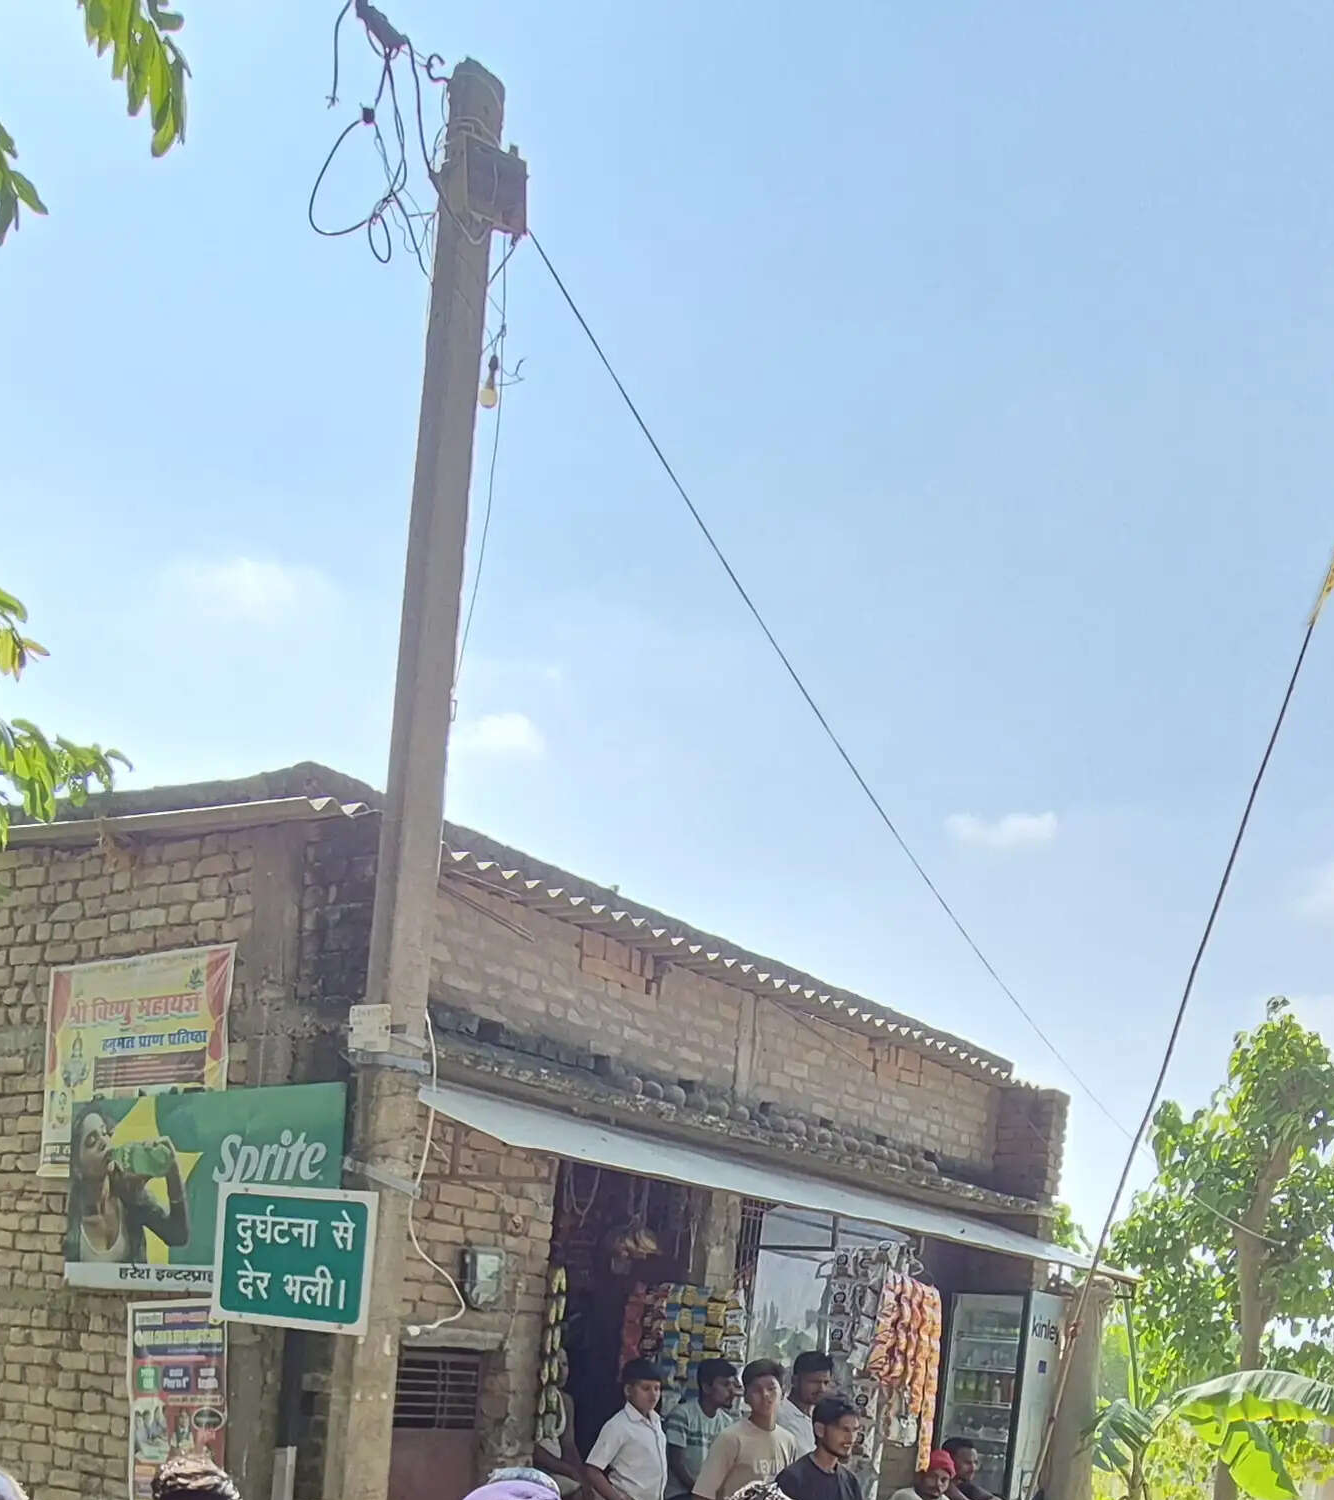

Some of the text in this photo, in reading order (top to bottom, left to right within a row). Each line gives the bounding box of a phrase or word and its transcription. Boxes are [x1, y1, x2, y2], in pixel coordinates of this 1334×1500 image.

[212, 1129, 327, 1183] Sprite
[235, 1204, 356, 1254] दुर्घटना से
[237, 1259, 272, 1300] देर
[1031, 1314, 1060, 1345] kinley
